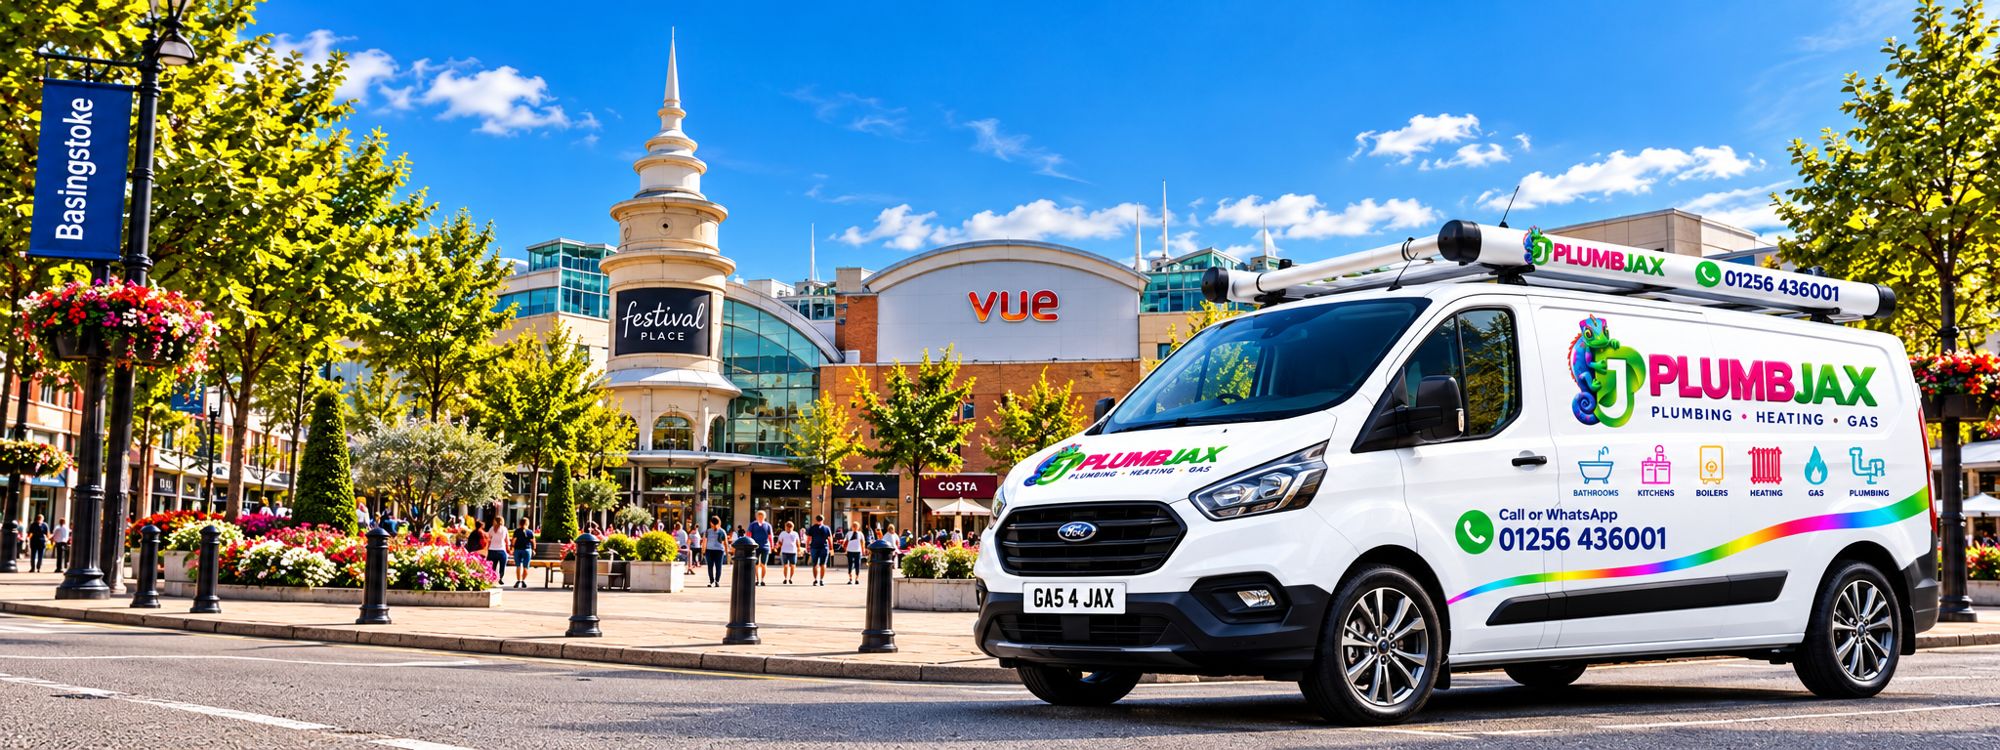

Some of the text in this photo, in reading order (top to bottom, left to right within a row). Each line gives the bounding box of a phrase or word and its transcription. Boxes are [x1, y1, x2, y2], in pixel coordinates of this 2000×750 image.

[55, 98, 97, 240] Basingstoke
[1553, 243, 1665, 277] PLUMBJAX
[1725, 270, 1839, 302] 01256 436001
[622, 300, 705, 338] festival
[640, 331, 685, 341] PLACE
[1649, 354, 1878, 407] PLUMBJAX
[1651, 406, 1879, 428] PLUMBING HEATING GAS
[1075, 445, 1228, 472] PLUMBJAX
[1068, 471, 1118, 480] PLUMBING
[763, 479, 801, 490] NEXT
[846, 480, 886, 491] ZARA
[938, 481, 978, 491] COSTA
[1573, 489, 1619, 497] BATHROOMS
[1637, 489, 1675, 497] KITCHENS
[1696, 489, 1729, 497] BOILERS
[1750, 489, 1783, 497] HEATING
[1808, 489, 1824, 497] GAS
[1849, 489, 1890, 497] PLUMBING
[1499, 508, 1618, 523] Call or WhatsApp
[1499, 526, 1666, 551] 01256 436001
[1083, 588, 1114, 608] JAX
